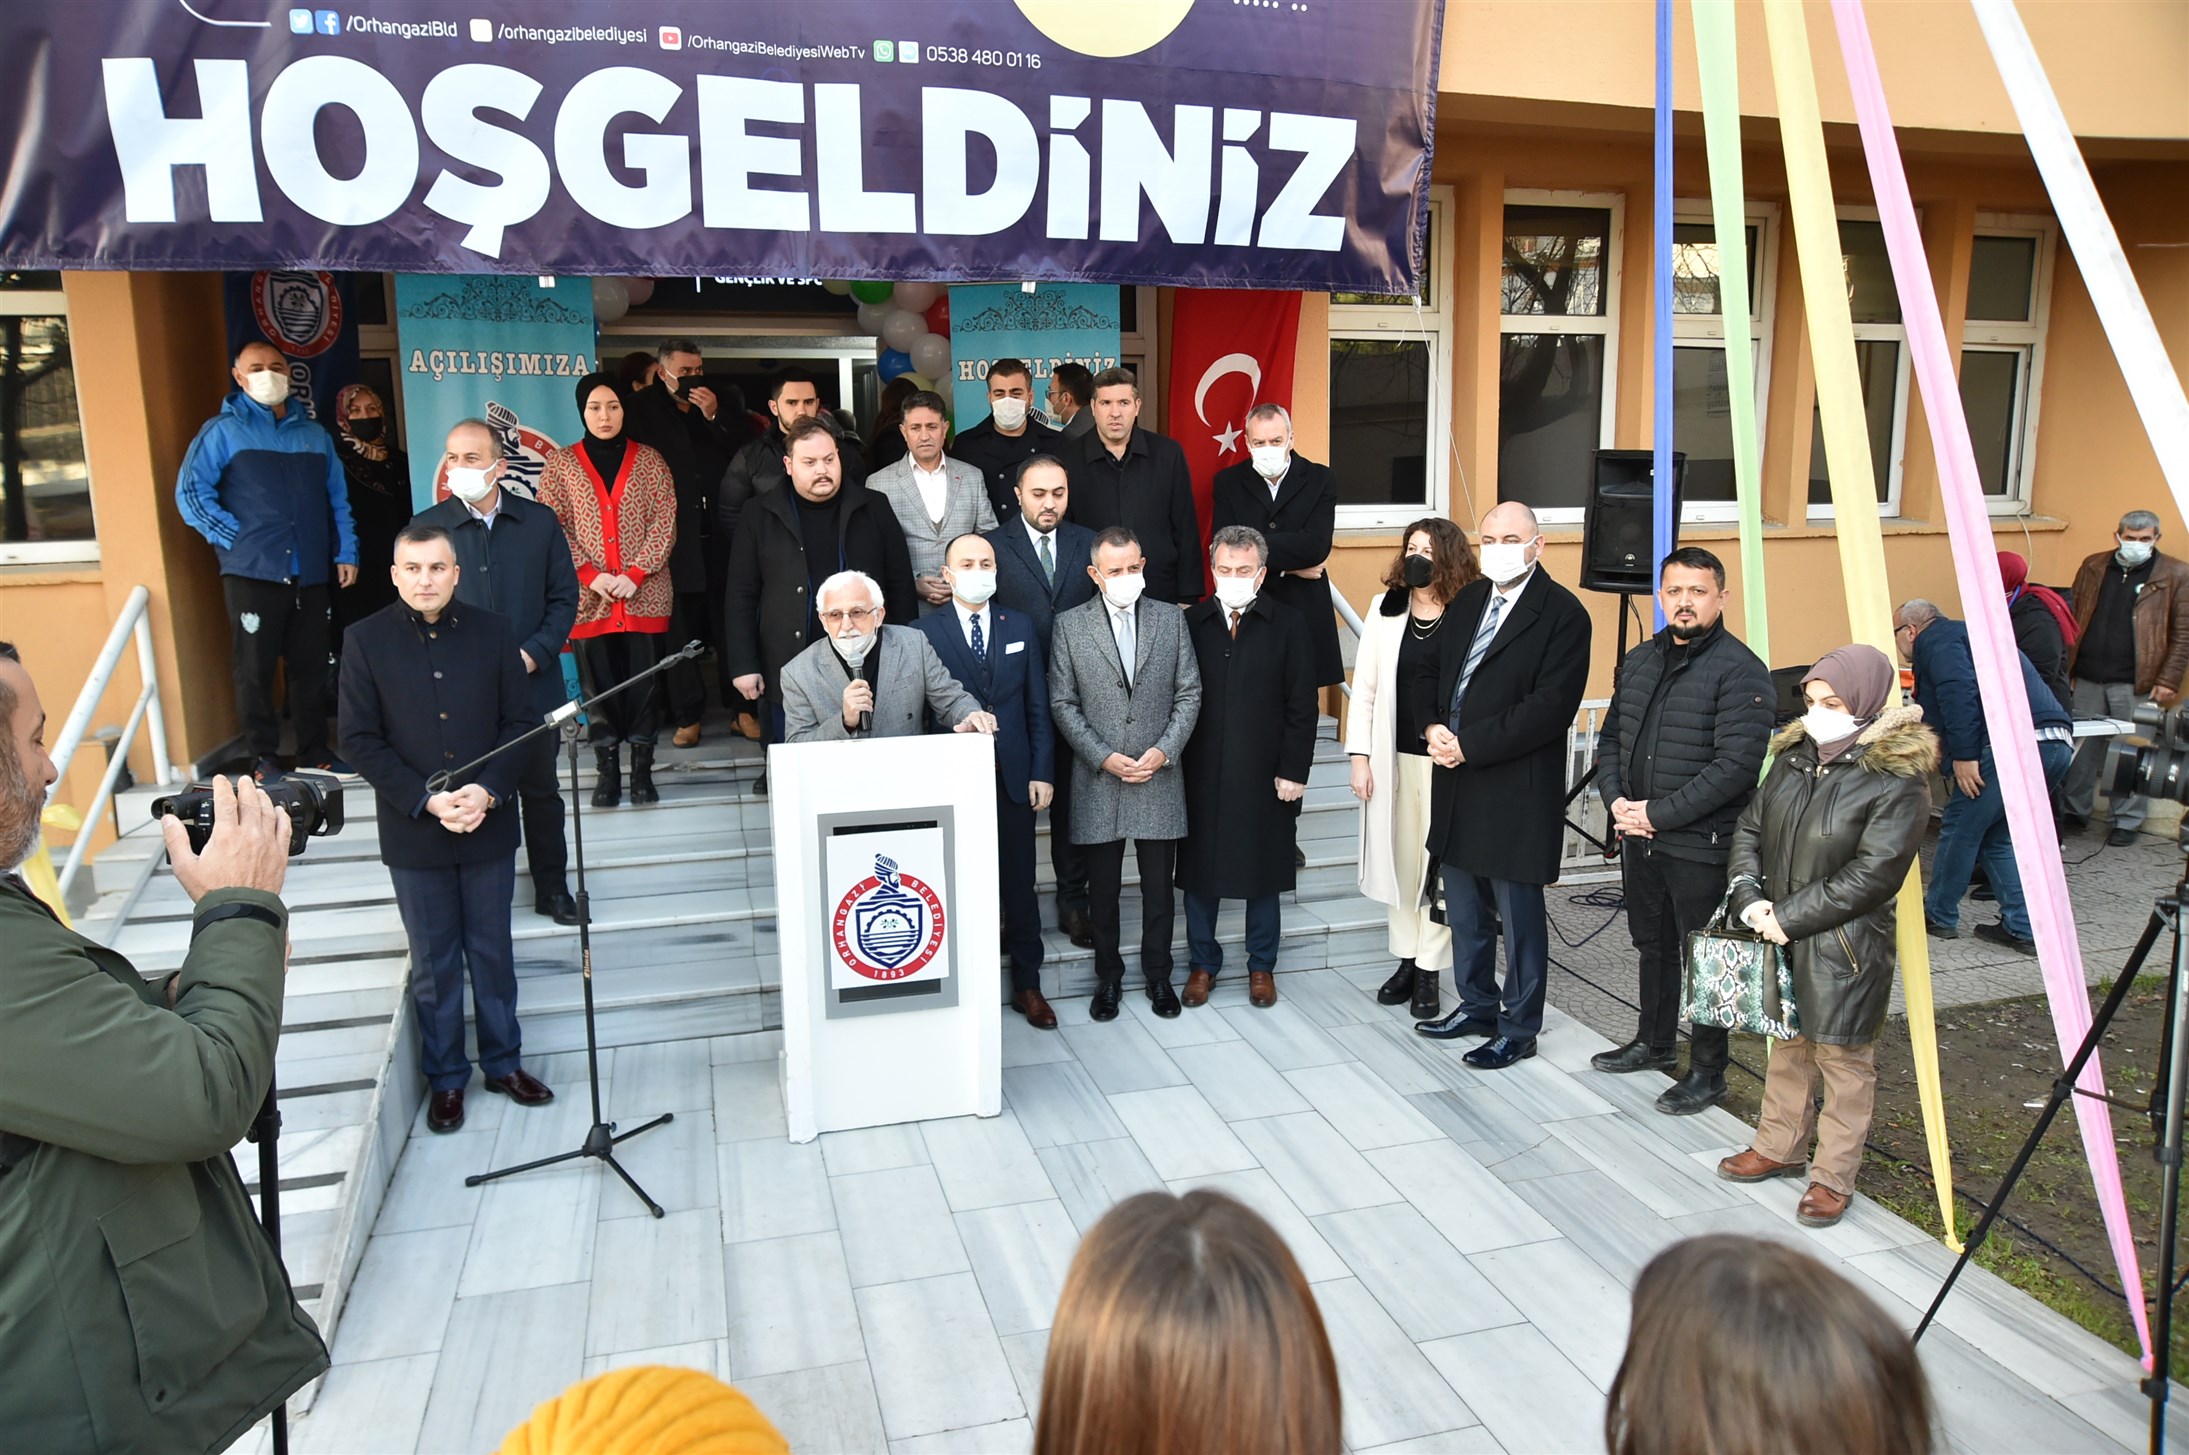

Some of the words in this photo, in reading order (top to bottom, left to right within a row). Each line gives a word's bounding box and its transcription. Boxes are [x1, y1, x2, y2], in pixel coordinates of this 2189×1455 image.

[346, 15, 458, 39] /OrhangaziBld
[498, 23, 647, 45] /orhangazibelediyesi
[687, 35, 865, 60] /OrhangaziBelediyesiWebTv
[926, 46, 968, 63] 0538
[971, 49, 1003, 66] 480
[408, 349, 592, 382] AÇILIŞIMIZA
[873, 968, 905, 979] 1893
